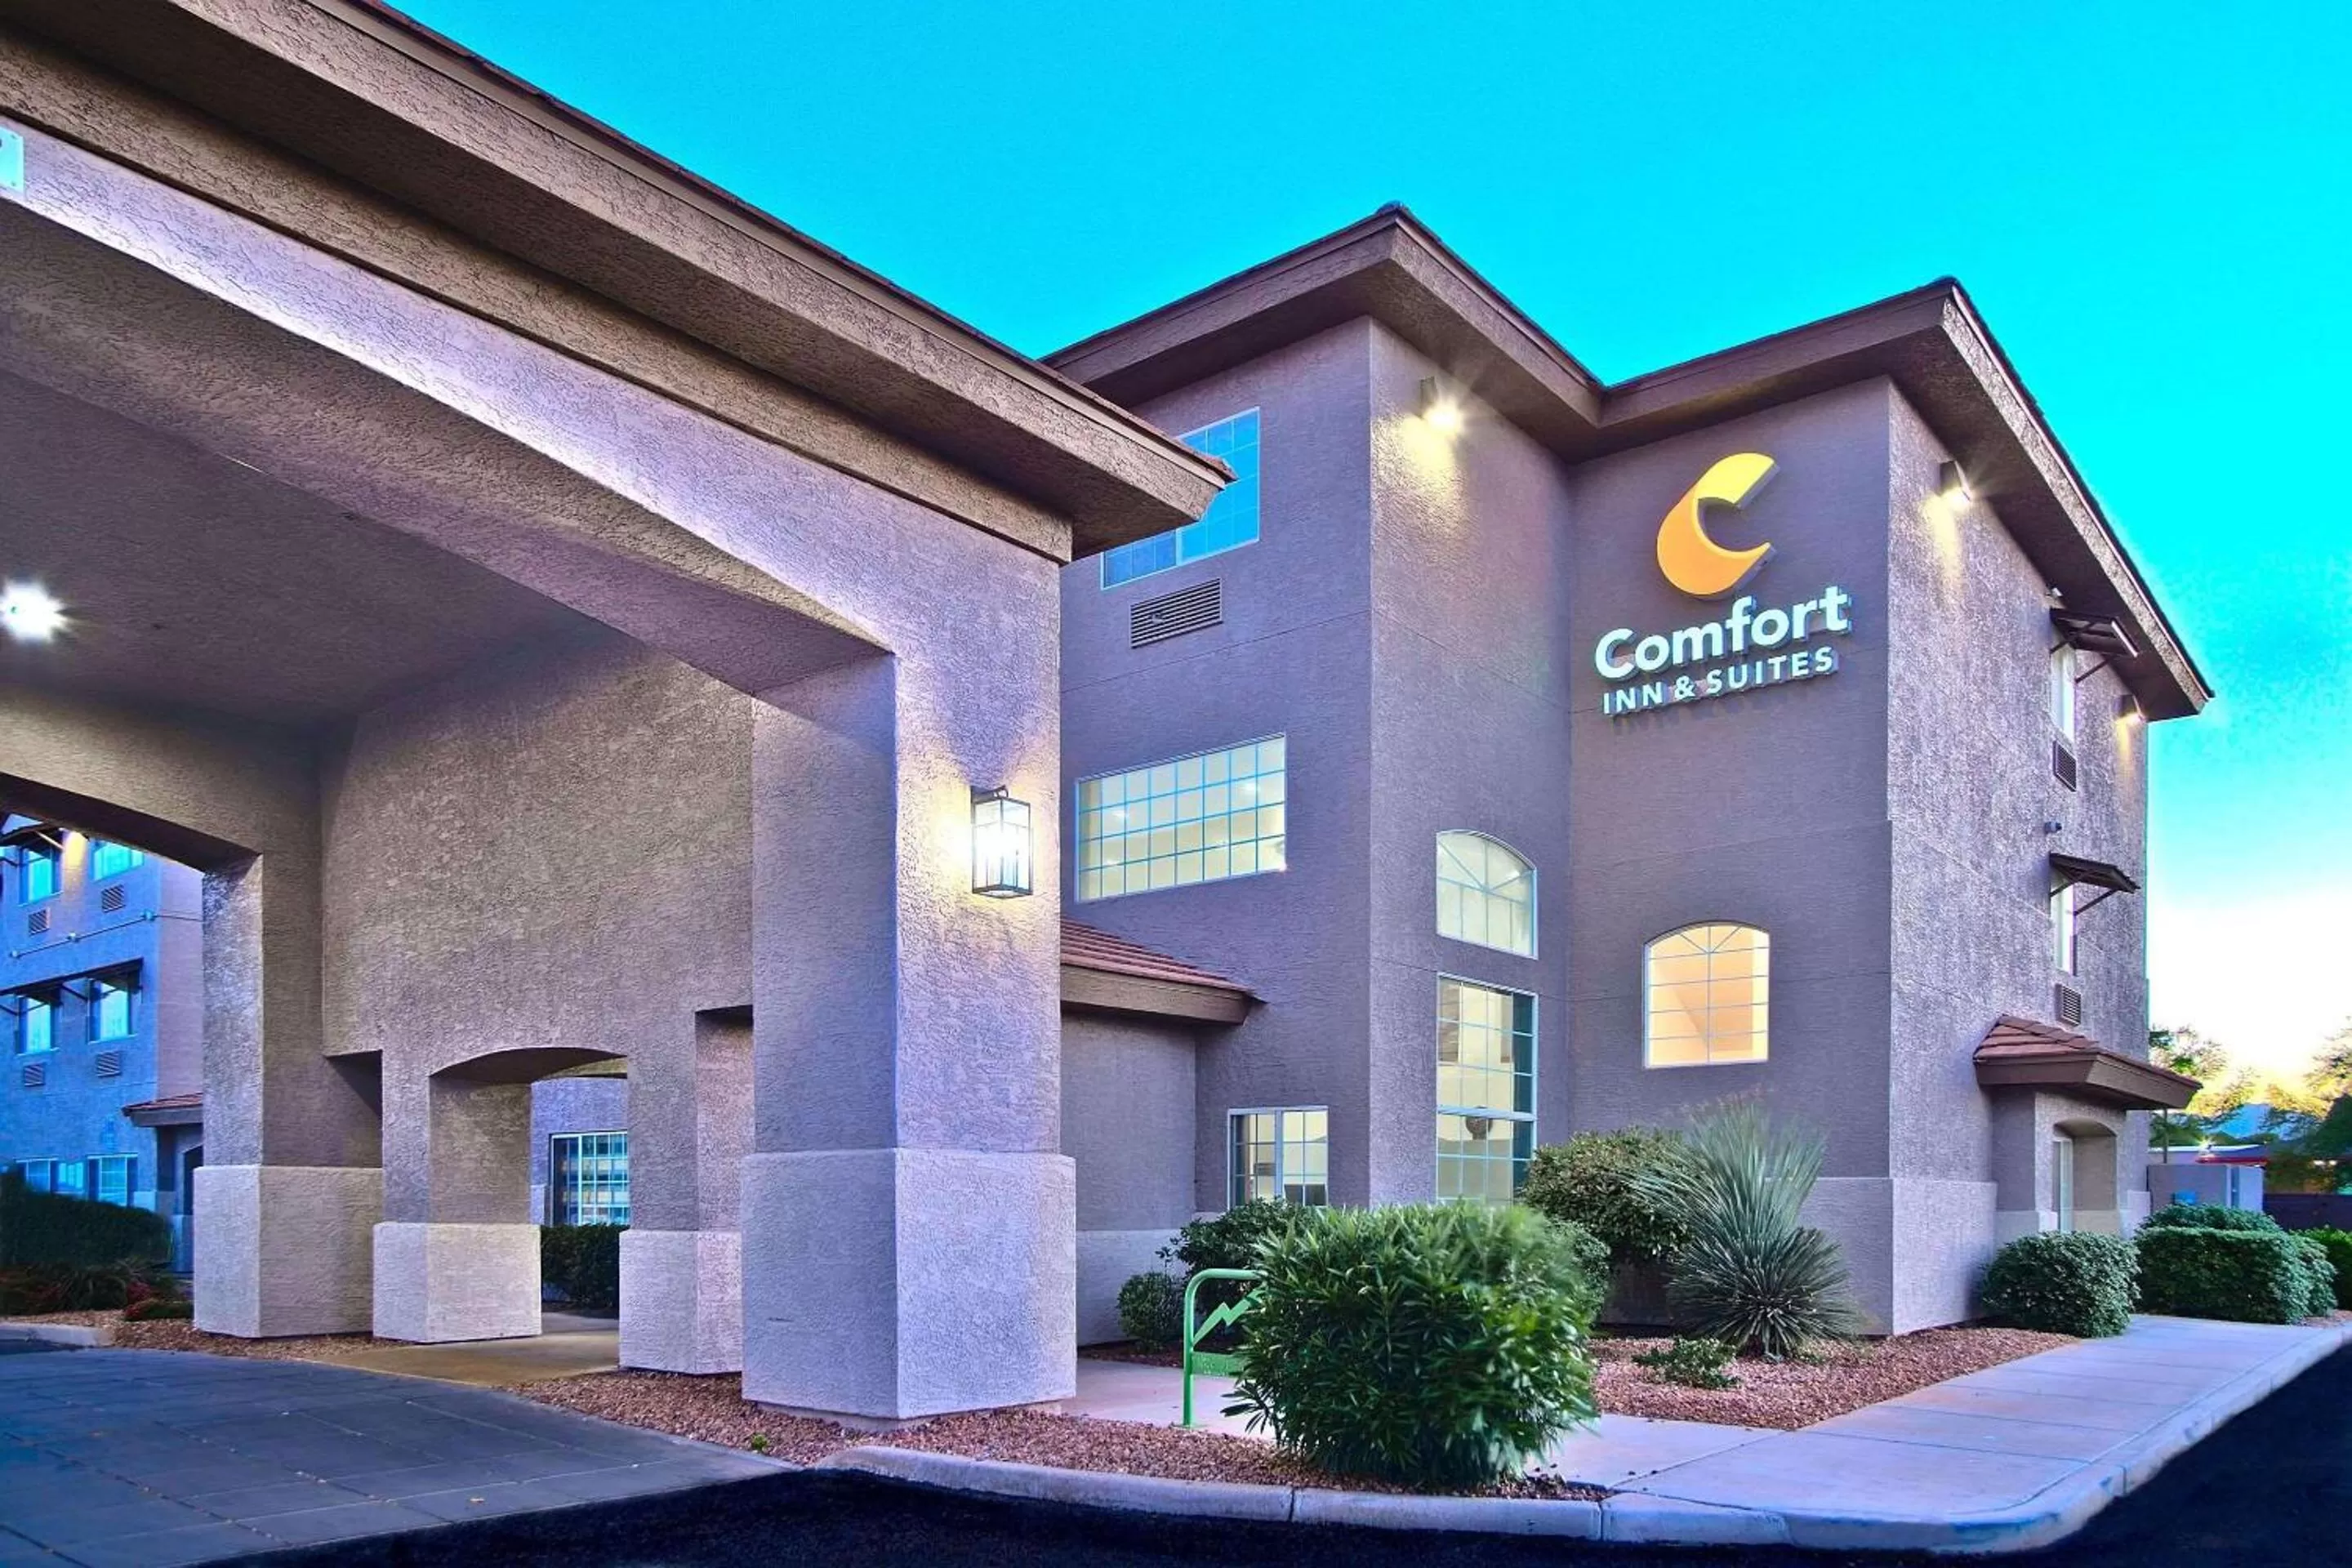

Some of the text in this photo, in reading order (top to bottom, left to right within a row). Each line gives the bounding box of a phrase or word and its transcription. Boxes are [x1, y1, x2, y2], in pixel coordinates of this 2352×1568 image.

[1595, 586, 1851, 679] Comfort
[1603, 646, 1836, 715] INN & SUITES
